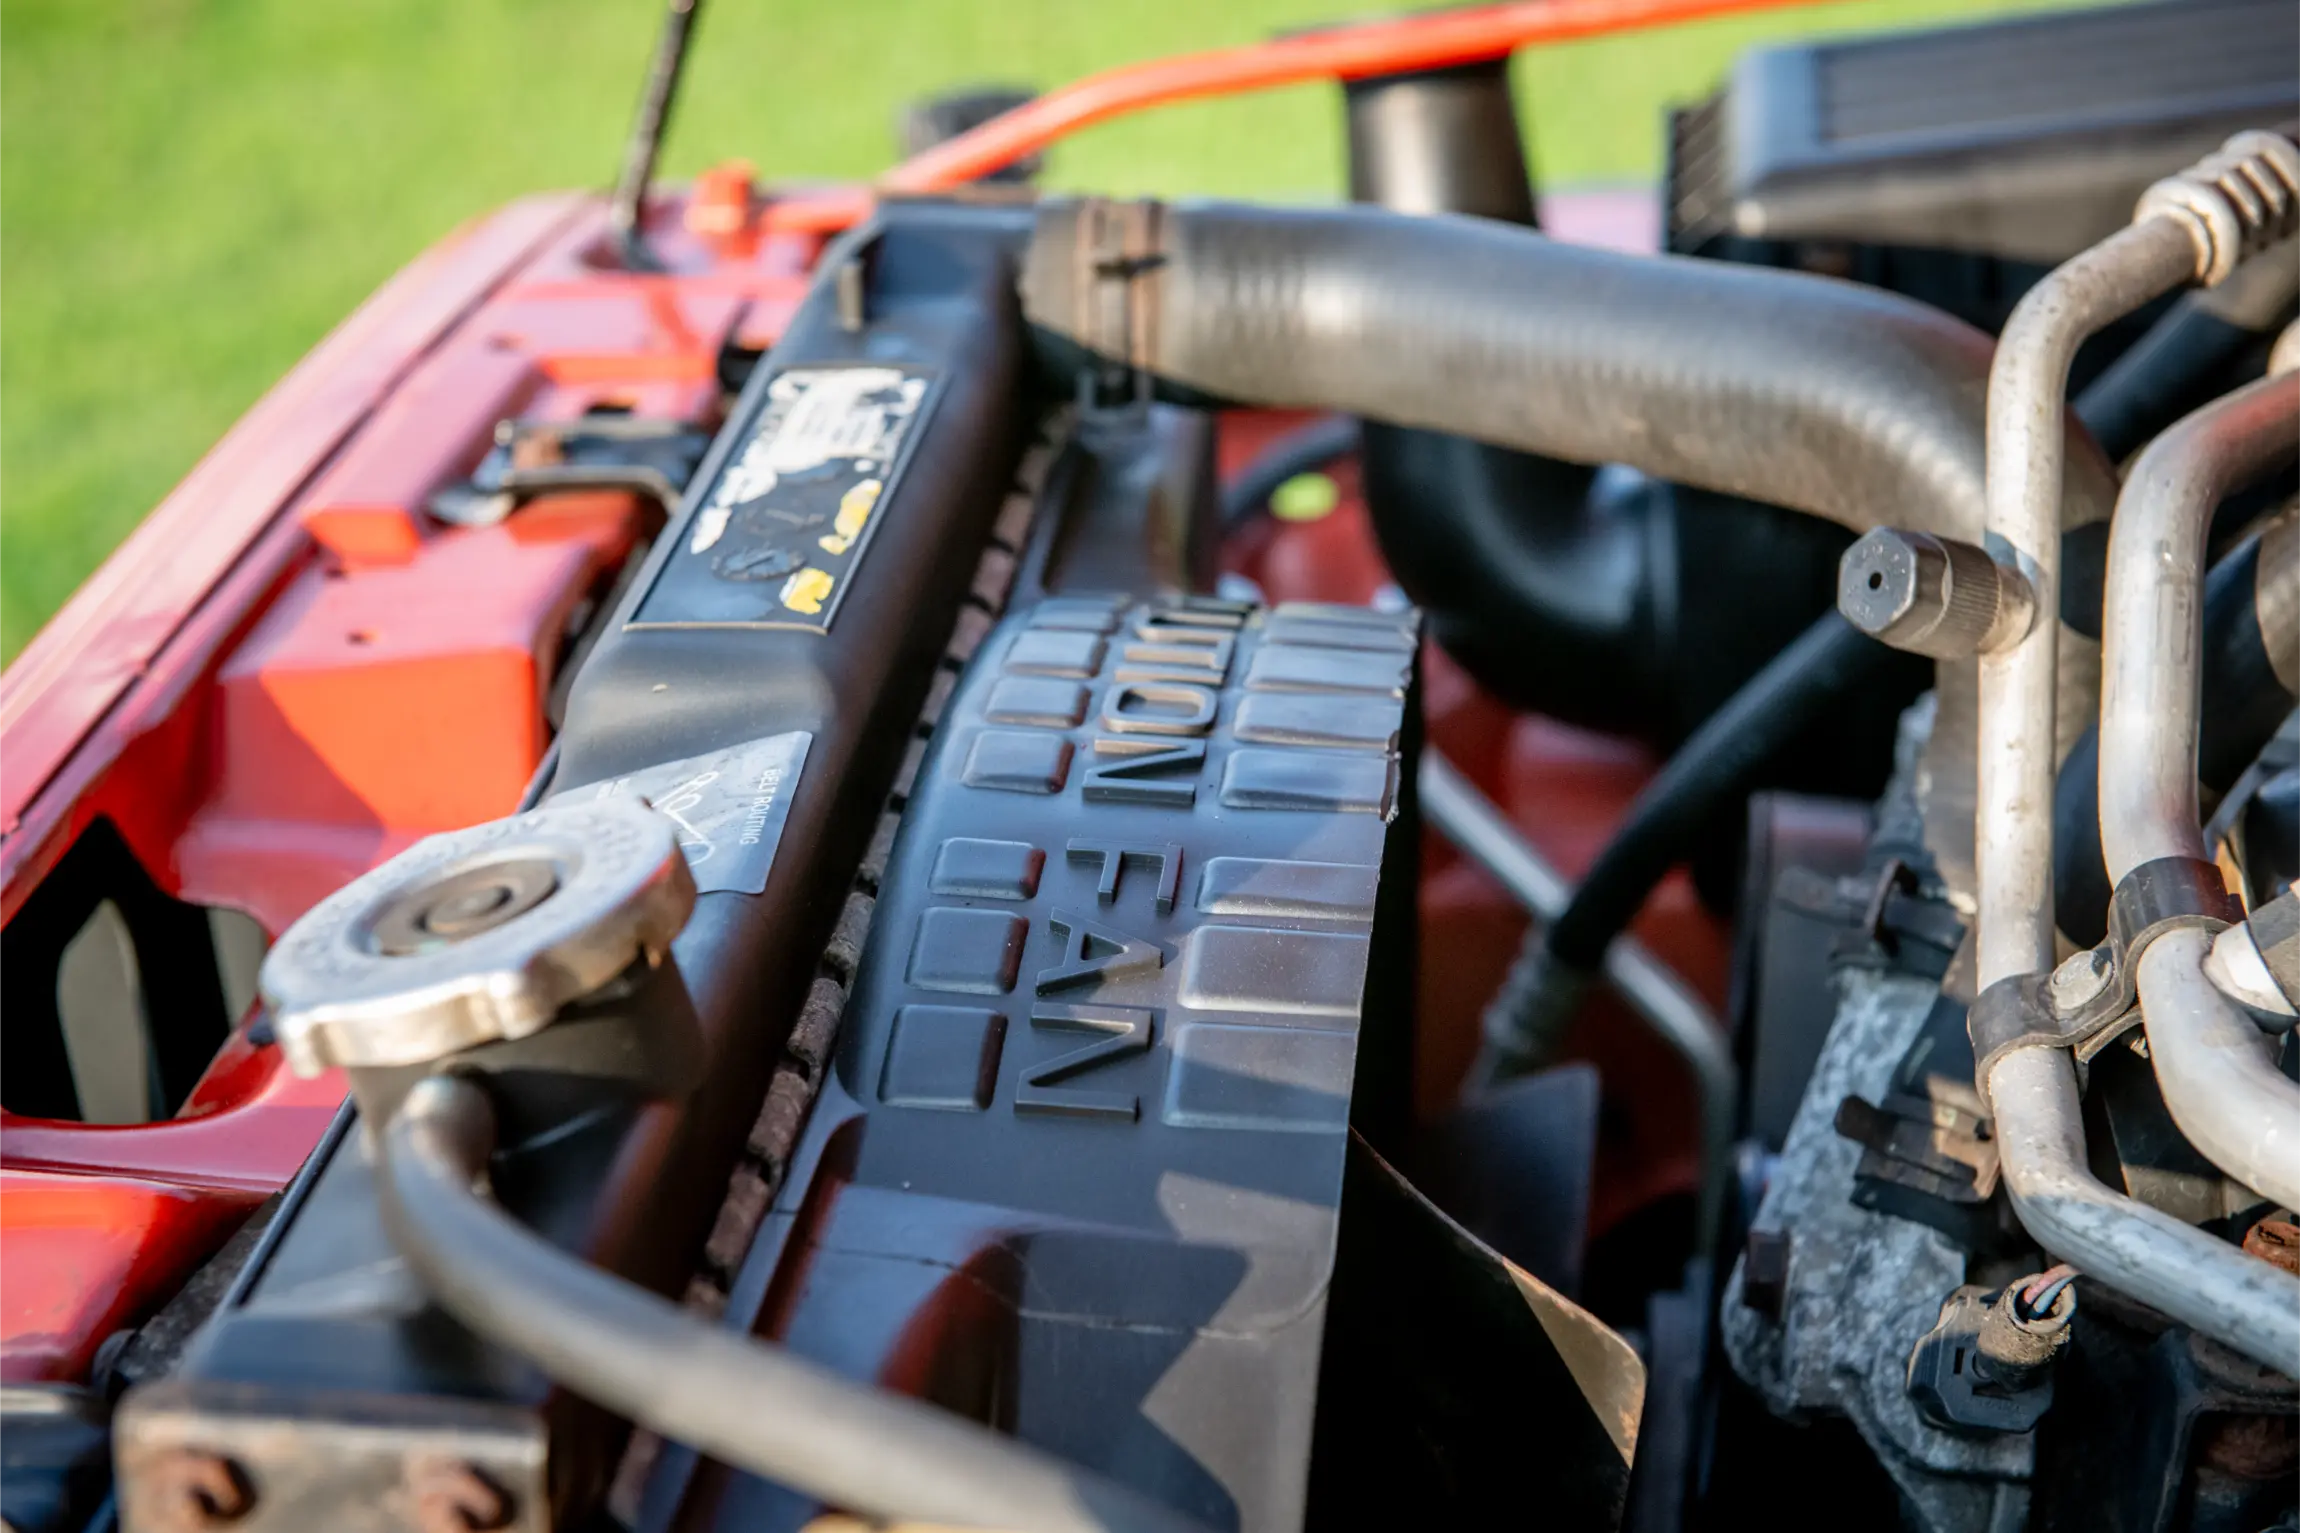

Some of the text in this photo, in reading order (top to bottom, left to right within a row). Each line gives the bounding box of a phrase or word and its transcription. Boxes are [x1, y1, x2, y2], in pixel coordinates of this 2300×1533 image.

[739, 768, 784, 845] BELT ROUTING
[1013, 598, 1256, 1123] UTION FAN
